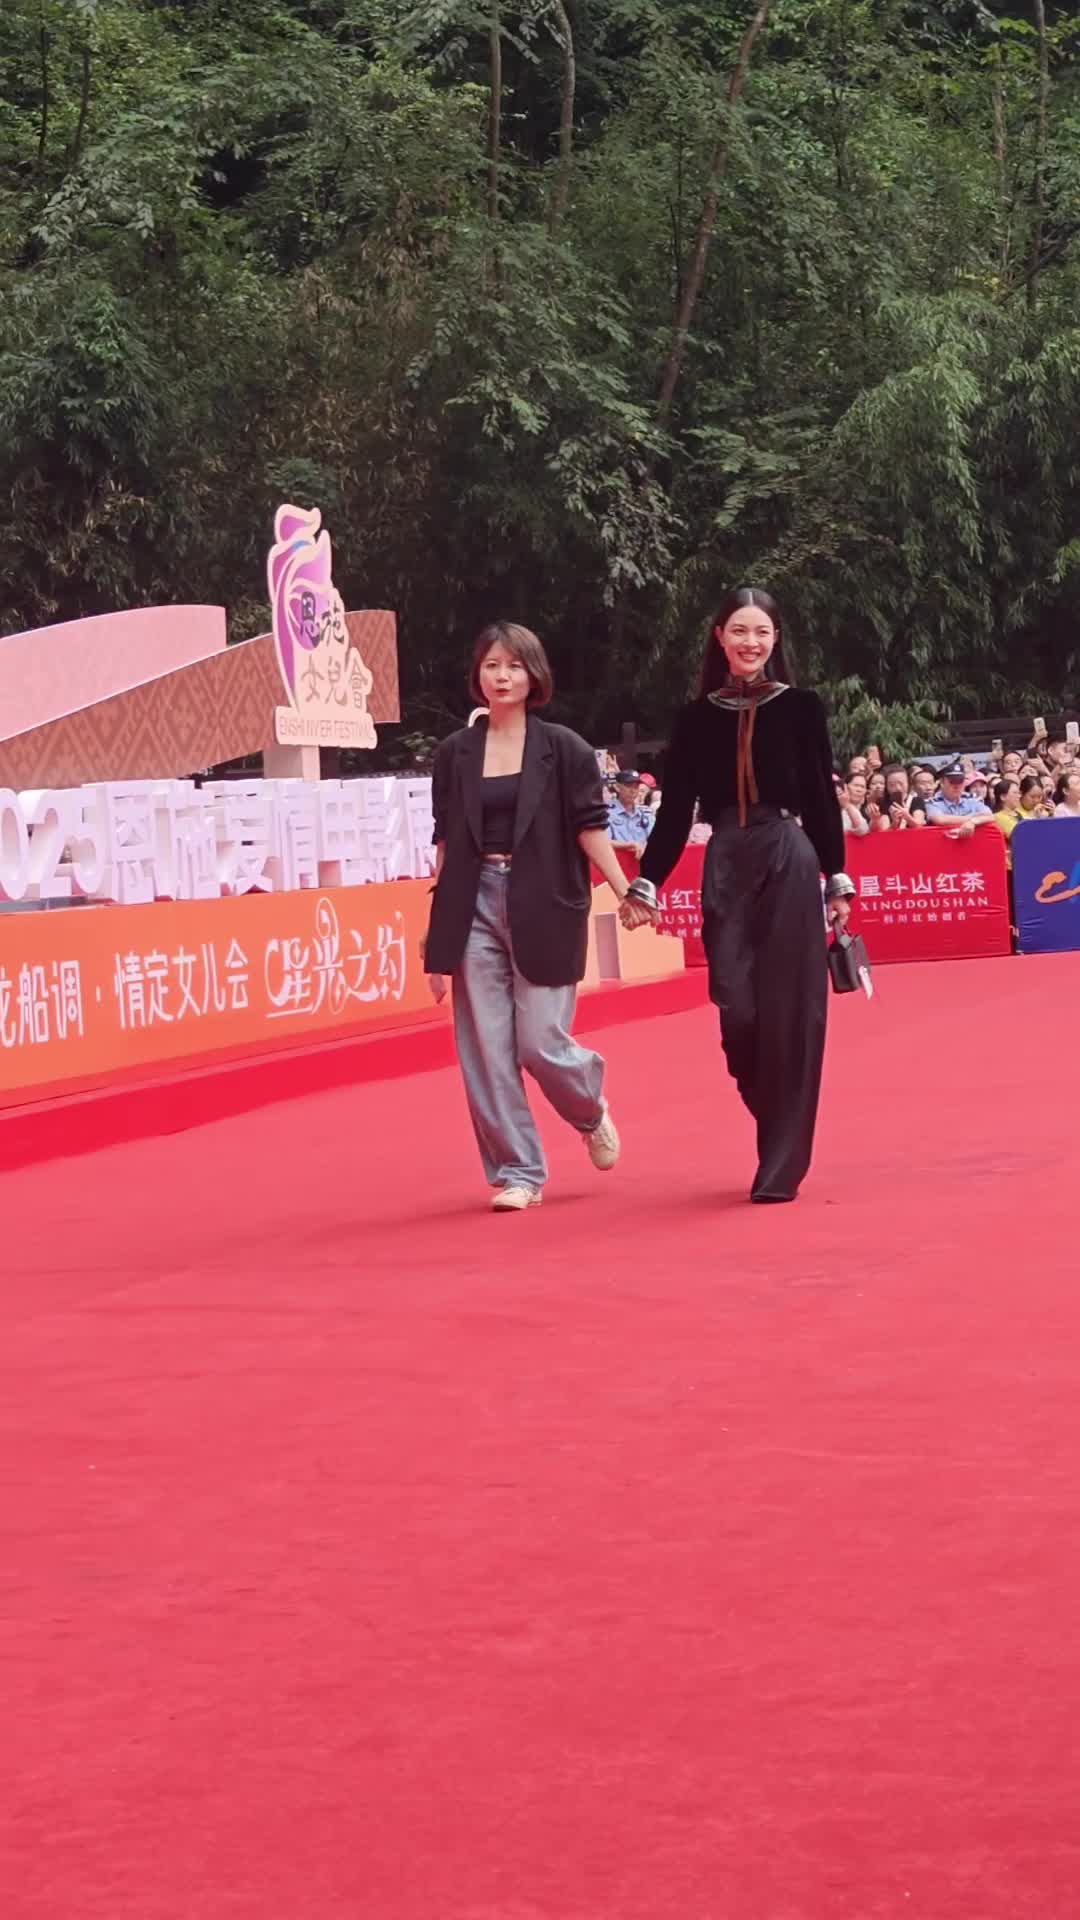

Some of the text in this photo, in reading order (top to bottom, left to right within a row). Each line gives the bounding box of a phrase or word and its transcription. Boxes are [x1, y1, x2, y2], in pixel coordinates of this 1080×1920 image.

[300, 591, 345, 648] 恩施
[859, 872, 985, 897] 星斗山红茶
[860, 896, 989, 912] XINGDOUSHAN
